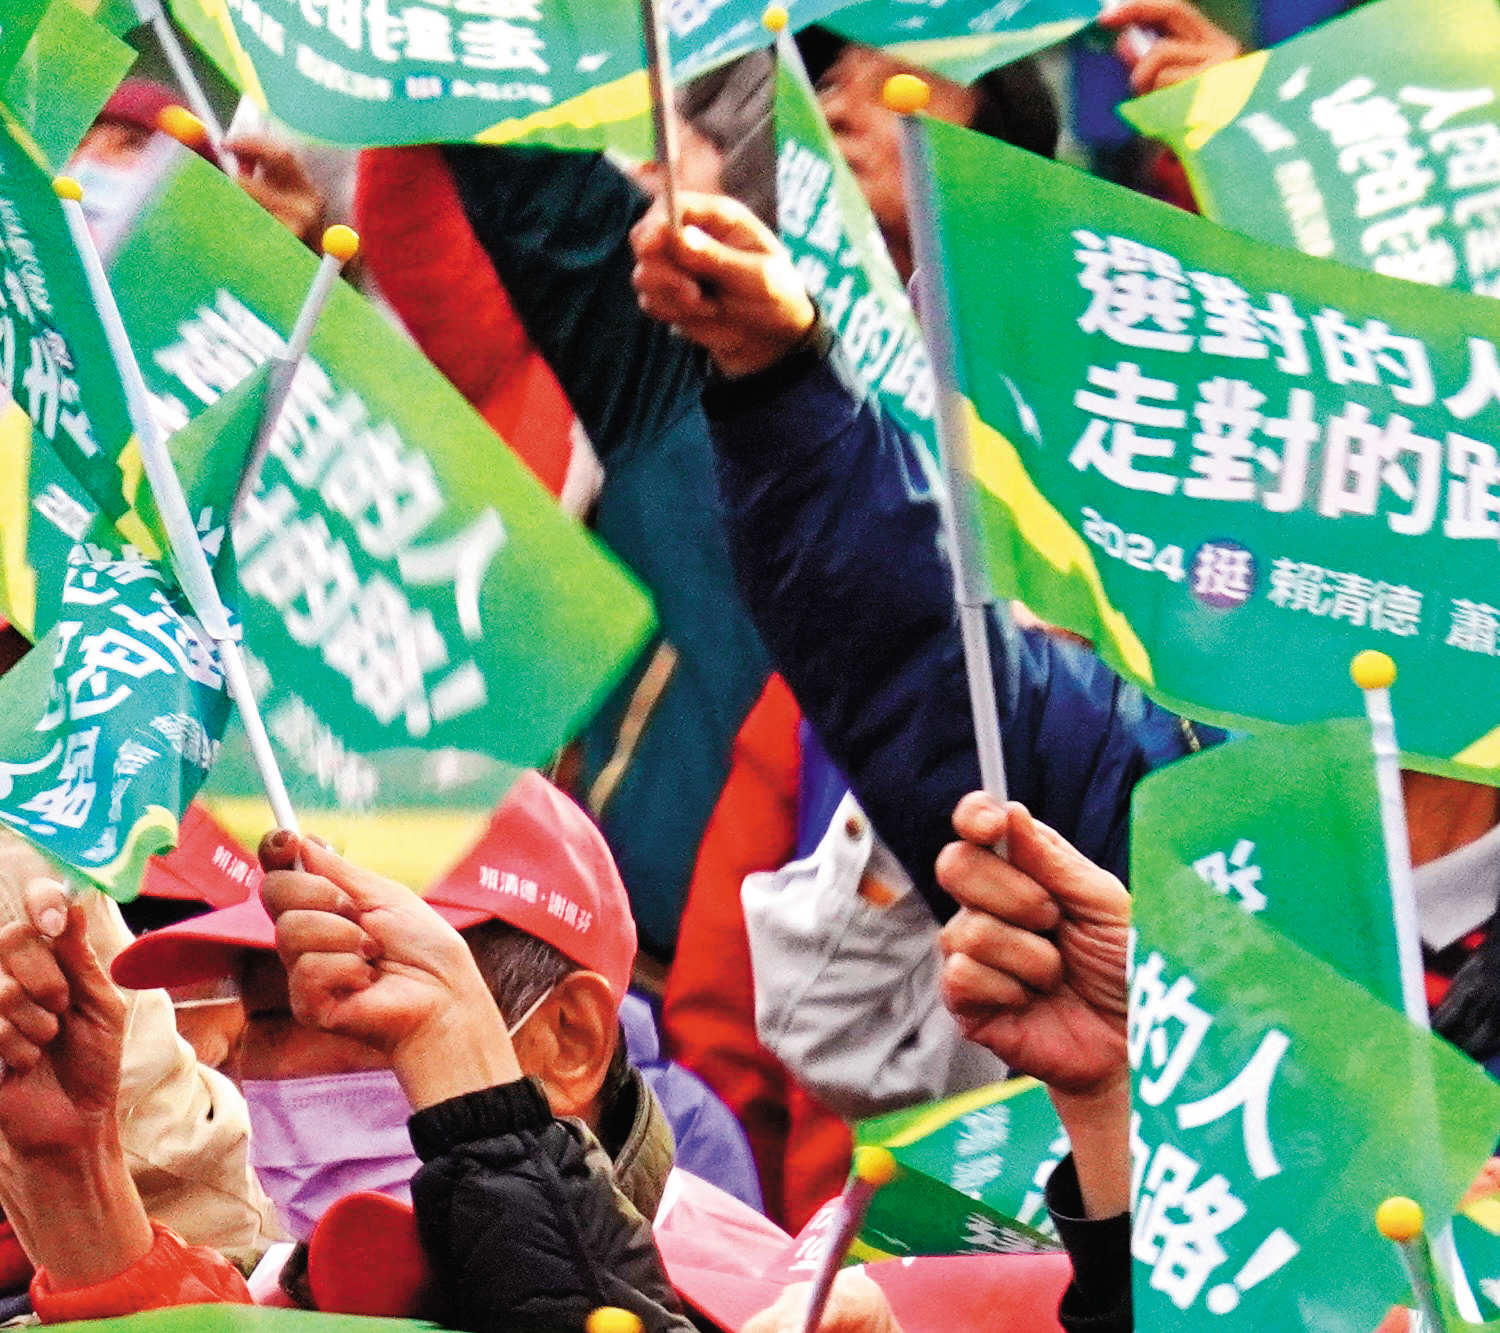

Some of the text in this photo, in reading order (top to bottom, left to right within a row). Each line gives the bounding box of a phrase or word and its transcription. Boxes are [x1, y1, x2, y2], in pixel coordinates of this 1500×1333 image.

[1080, 508, 1185, 581] 2024
[1192, 540, 1256, 604] 挺
[1267, 556, 1422, 640] 賴清德
